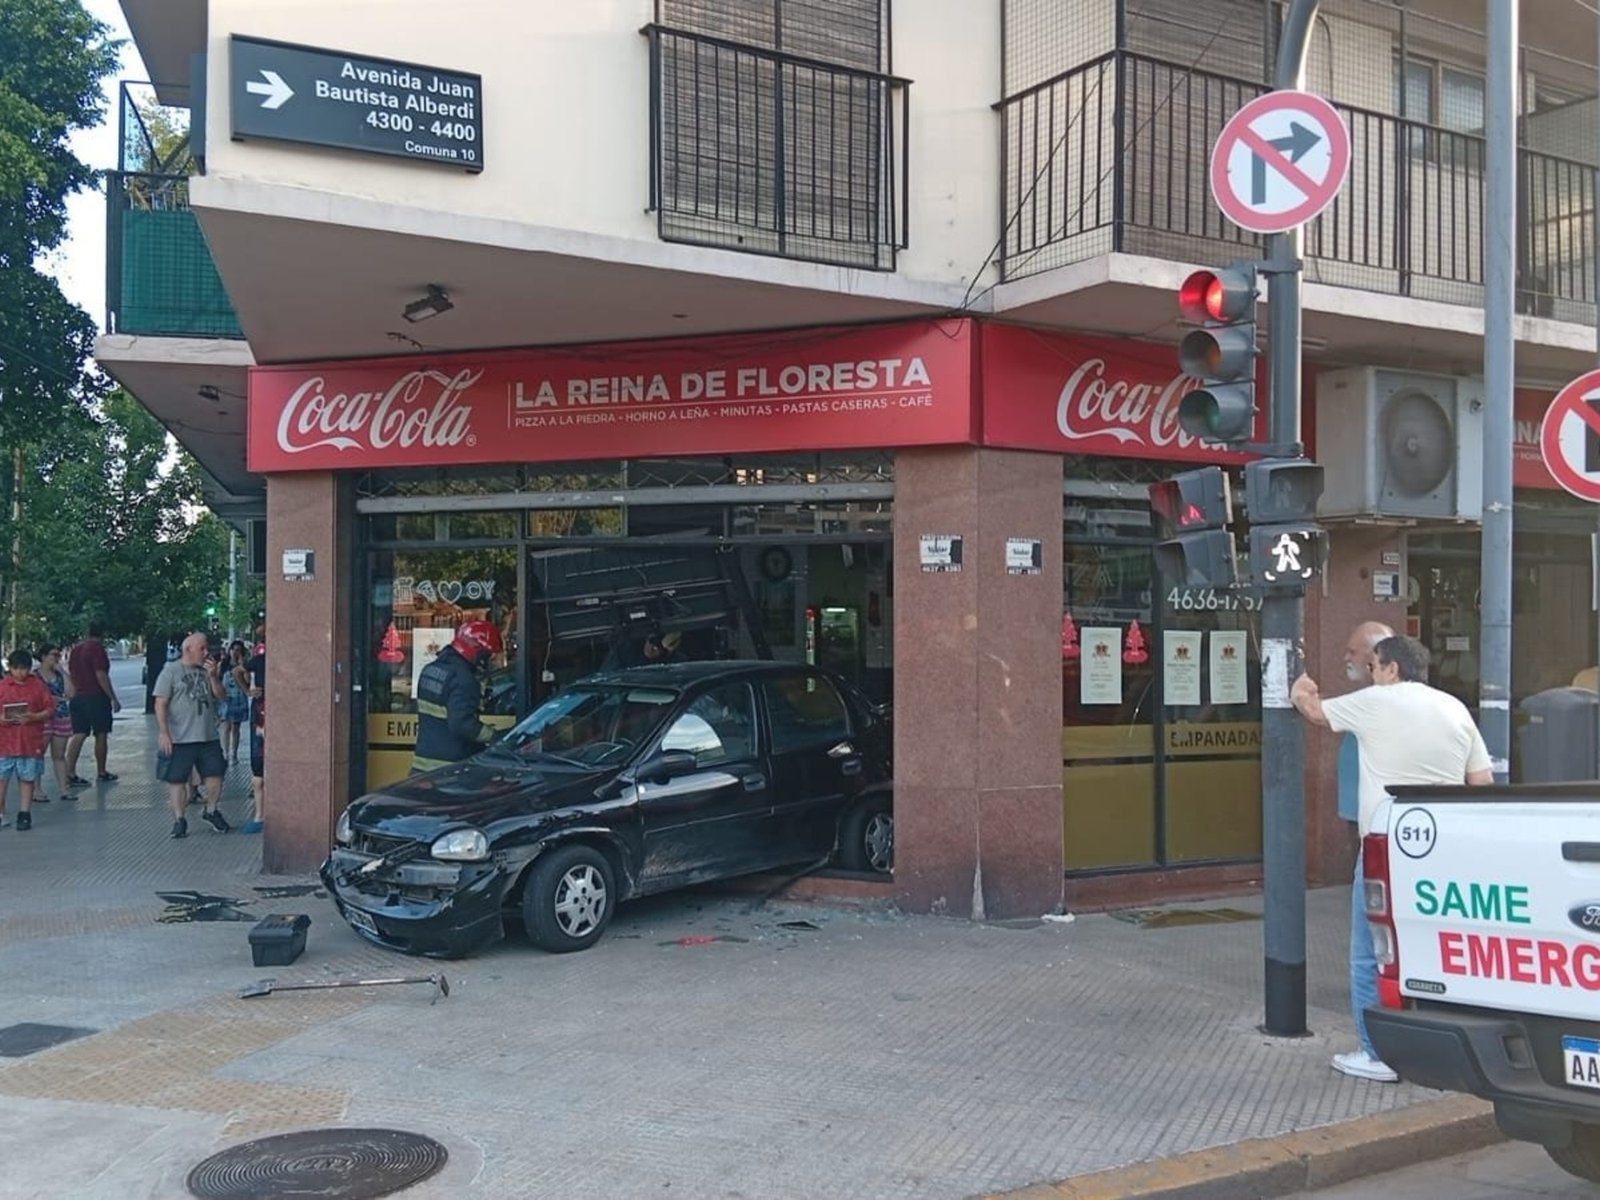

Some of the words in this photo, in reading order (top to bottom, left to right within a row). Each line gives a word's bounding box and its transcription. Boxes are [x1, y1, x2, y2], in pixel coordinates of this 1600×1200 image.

[341, 62, 421, 90] Avenida
[427, 77, 473, 98] Juan
[316, 81, 398, 108] Bautista
[405, 95, 474, 119] Alberdi
[367, 111, 413, 132] 4300
[431, 123, 475, 141] 4400
[405, 140, 457, 158] Comuna
[461, 149, 475, 160] 10
[516, 381, 557, 408] LA
[568, 374, 670, 405] REINA
[681, 370, 725, 399] DE
[737, 357, 931, 396] FLORESTA
[277, 368, 484, 453] Coca-Cola
[515, 415, 546, 427] PIZZA
[549, 416, 557, 425] A
[560, 414, 573, 425] LA
[576, 412, 615, 424] PIEDRA
[625, 410, 665, 422] HORNO
[669, 410, 677, 420] A
[680, 406, 710, 419] LEÑA
[720, 405, 772, 417] MINUTAS
[783, 402, 828, 414] PASTAS
[833, 398, 887, 411] CASERAS
[900, 394, 932, 407] CAFÉ
[1401, 826, 1430, 842] 511
[1415, 879, 1531, 924] SAME
[1438, 931, 1600, 992] EMERG
[1572, 1054, 1600, 1084] AA
